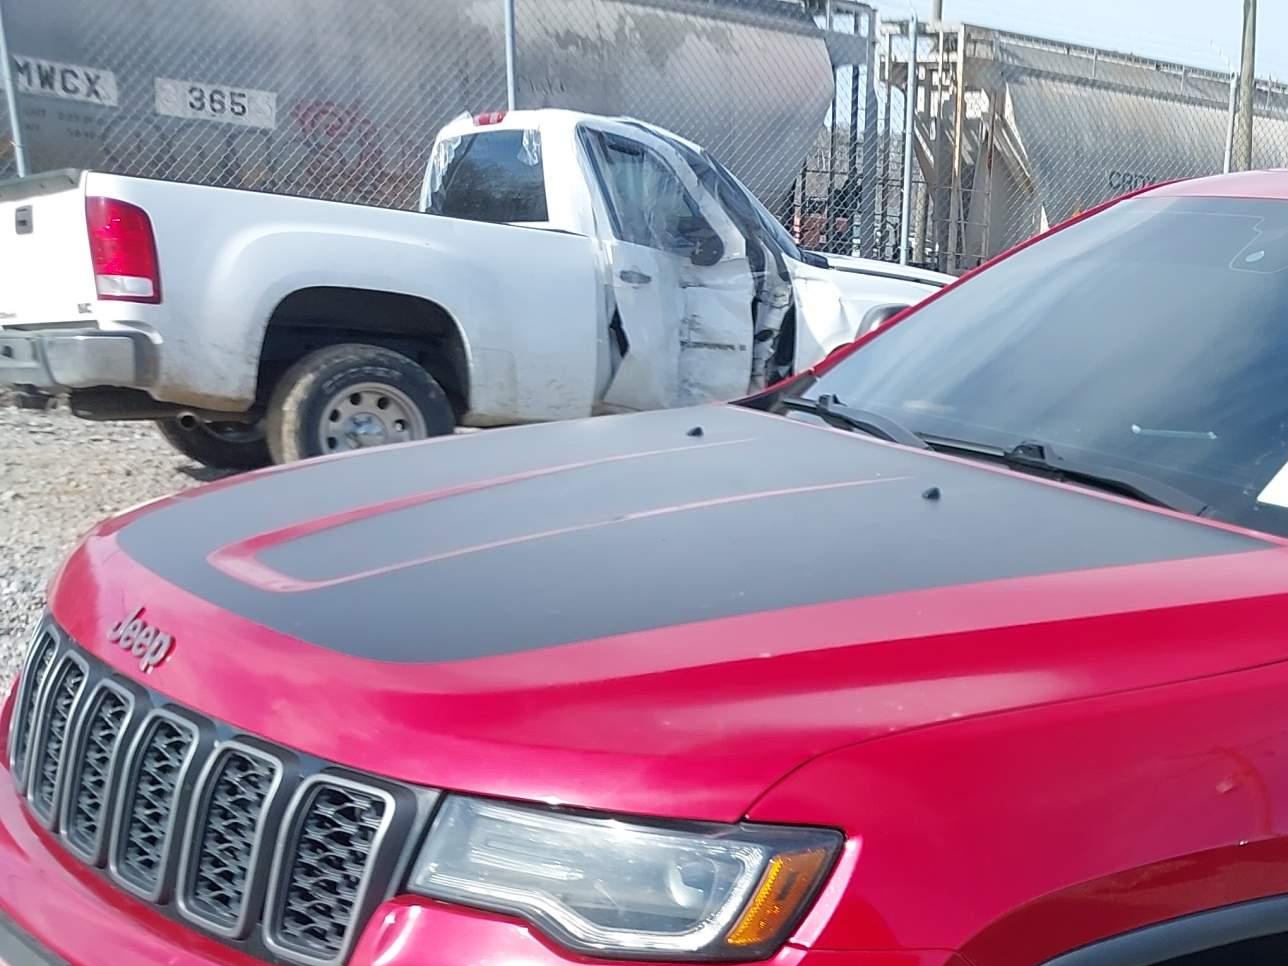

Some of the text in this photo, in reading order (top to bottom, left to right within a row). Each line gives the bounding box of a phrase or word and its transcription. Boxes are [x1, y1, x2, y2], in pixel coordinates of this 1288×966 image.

[13, 60, 102, 101] MWCX
[188, 86, 247, 117] 365
[107, 606, 174, 673] Jeep
